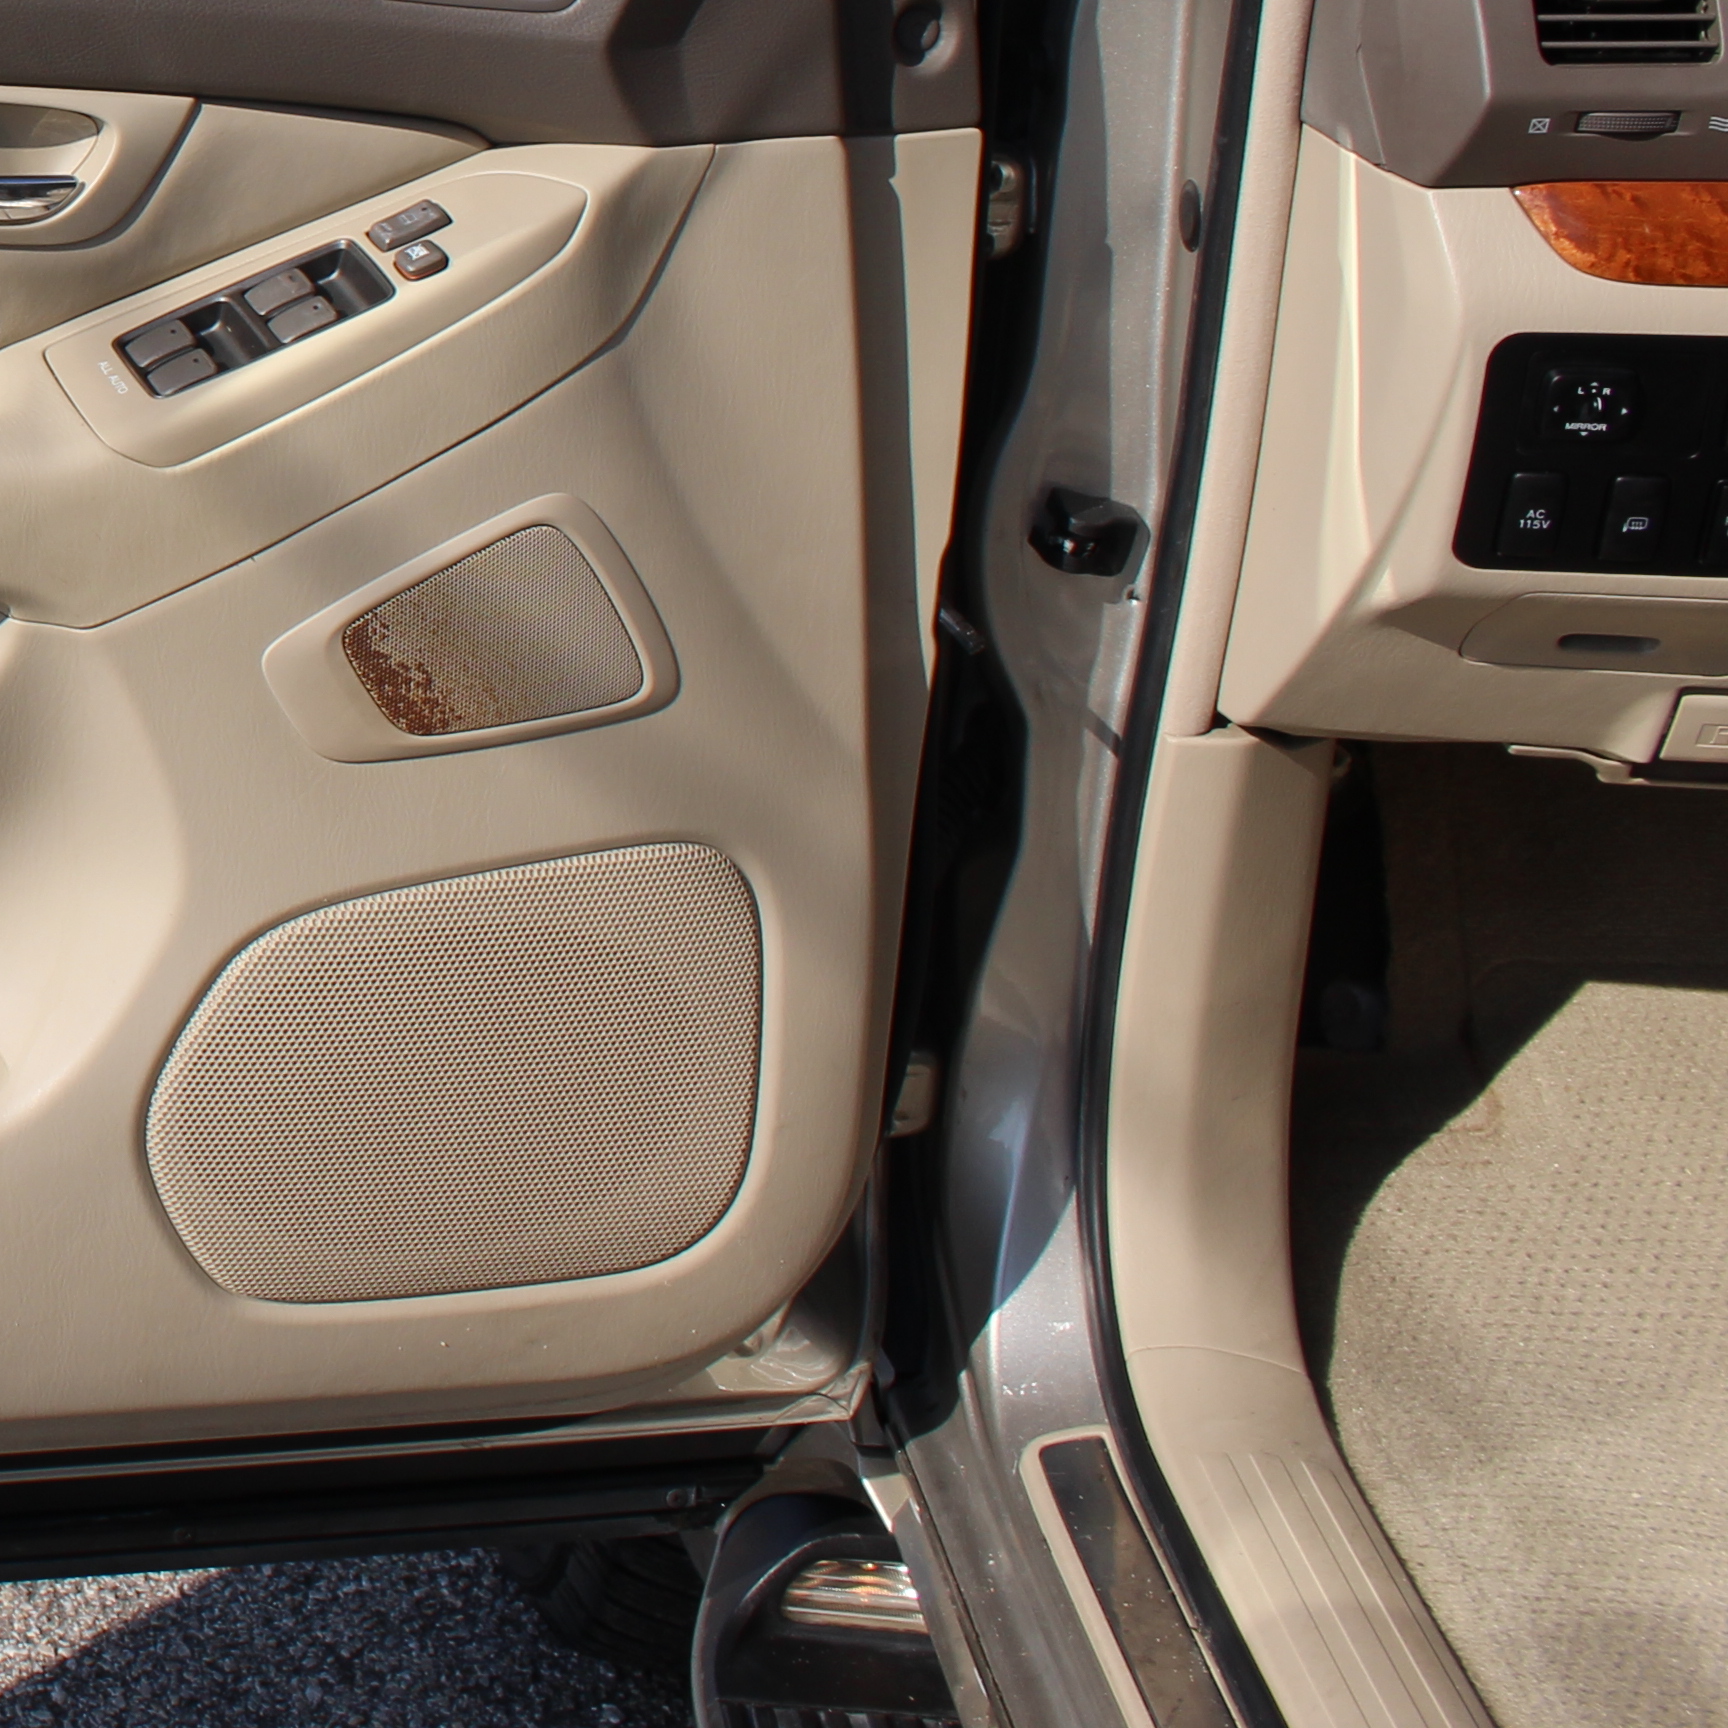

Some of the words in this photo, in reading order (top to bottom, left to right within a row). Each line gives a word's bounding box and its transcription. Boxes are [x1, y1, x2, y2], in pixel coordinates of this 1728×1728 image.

[108, 375, 129, 394] AUTO
[1577, 386, 1585, 395] L
[1602, 387, 1611, 395] R
[1564, 422, 1608, 432] MIRROR
[1526, 509, 1545, 519] AC
[1519, 519, 1551, 529] 115V
